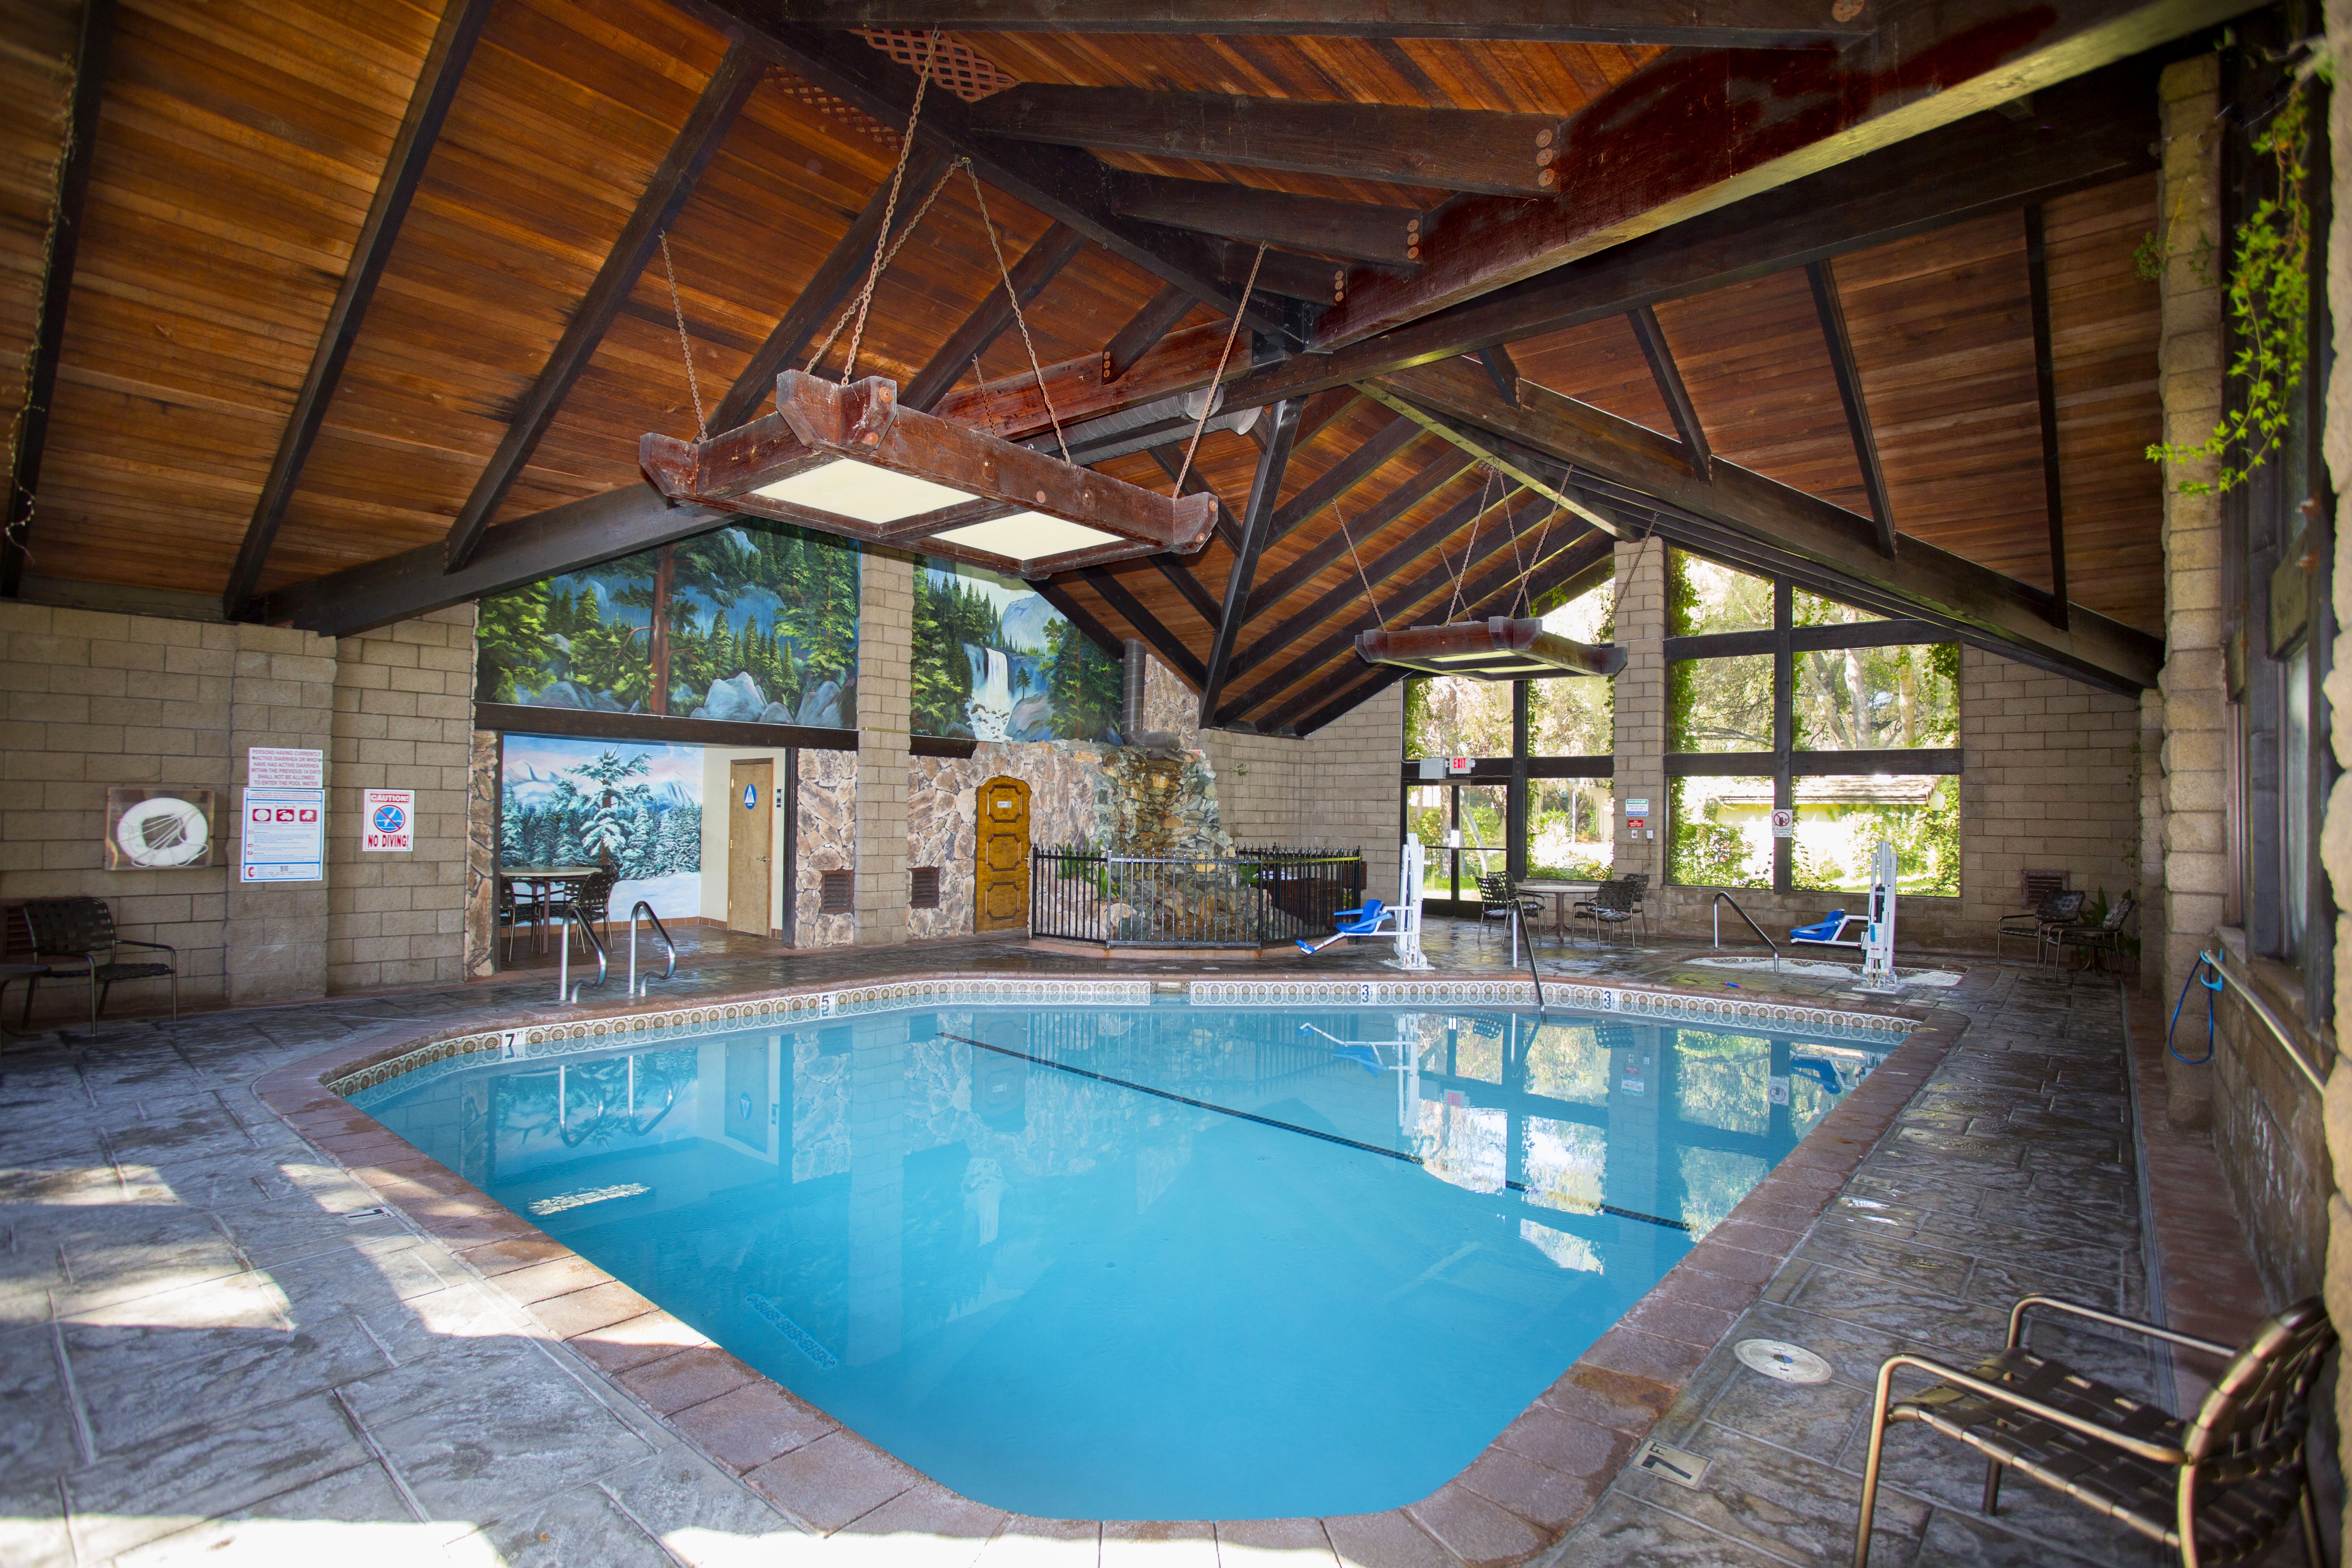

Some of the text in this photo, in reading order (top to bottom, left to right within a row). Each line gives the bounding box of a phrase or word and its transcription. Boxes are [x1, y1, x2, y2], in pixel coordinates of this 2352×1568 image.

[1453, 758, 1466, 768] EXIT
[368, 835, 409, 847] NO DIVING!
[1362, 984, 1369, 994] 3
[822, 995, 829, 1006] 5
[1604, 991, 1611, 1001] 3
[506, 1033, 515, 1047] 7
[347, 1208, 385, 1218] 7
[1641, 1441, 1692, 1480] FT 7
